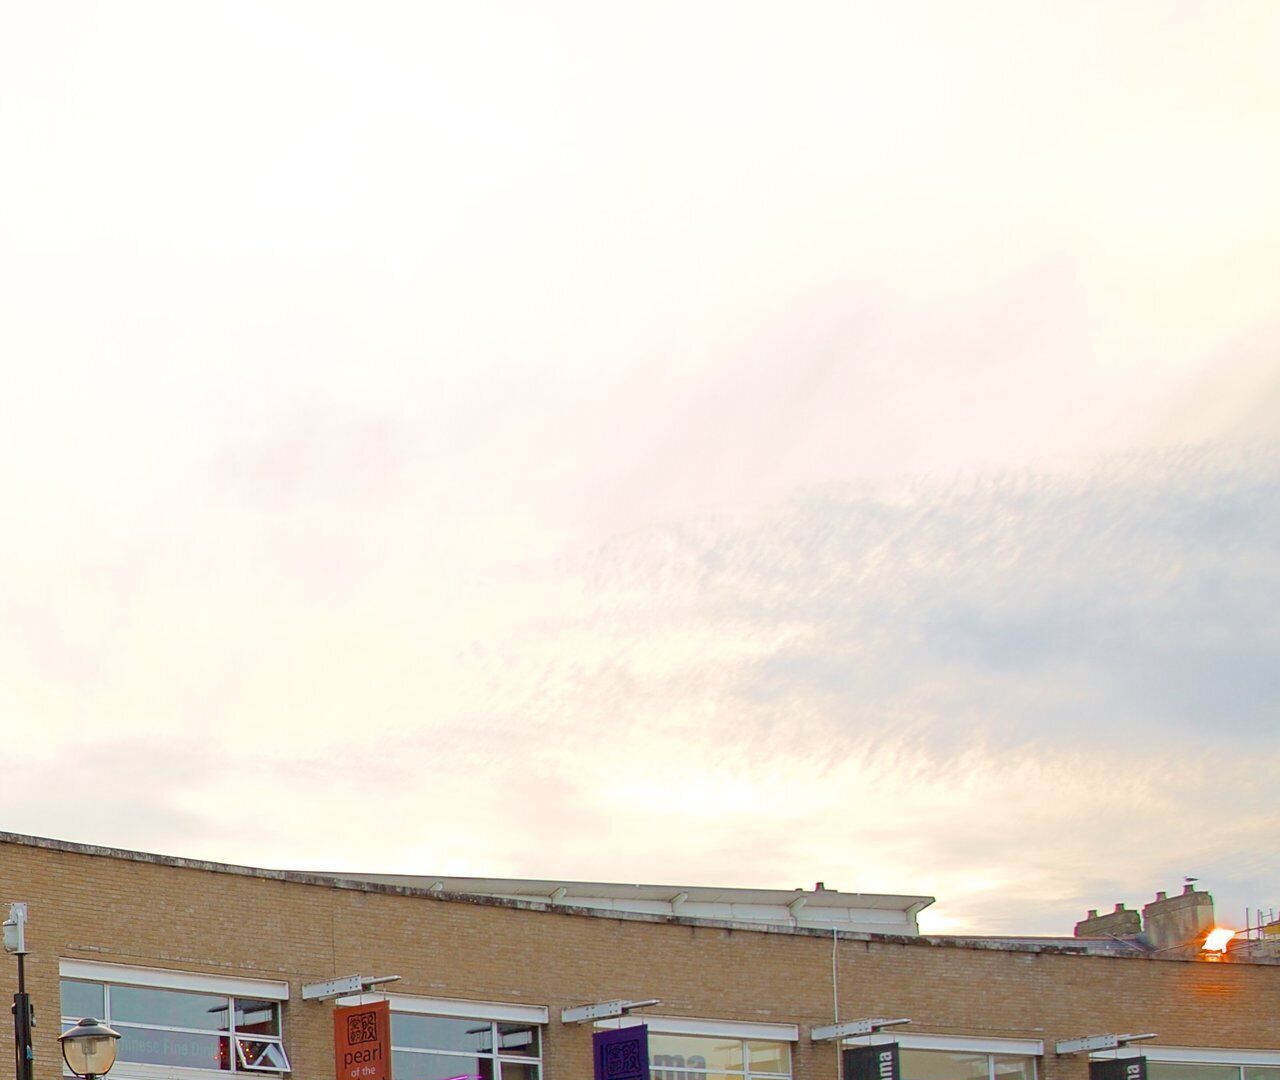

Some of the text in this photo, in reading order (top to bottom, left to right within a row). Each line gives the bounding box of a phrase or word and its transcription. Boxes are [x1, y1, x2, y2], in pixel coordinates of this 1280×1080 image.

[343, 1041, 383, 1070] pearl
[350, 1066, 376, 1078] of the
